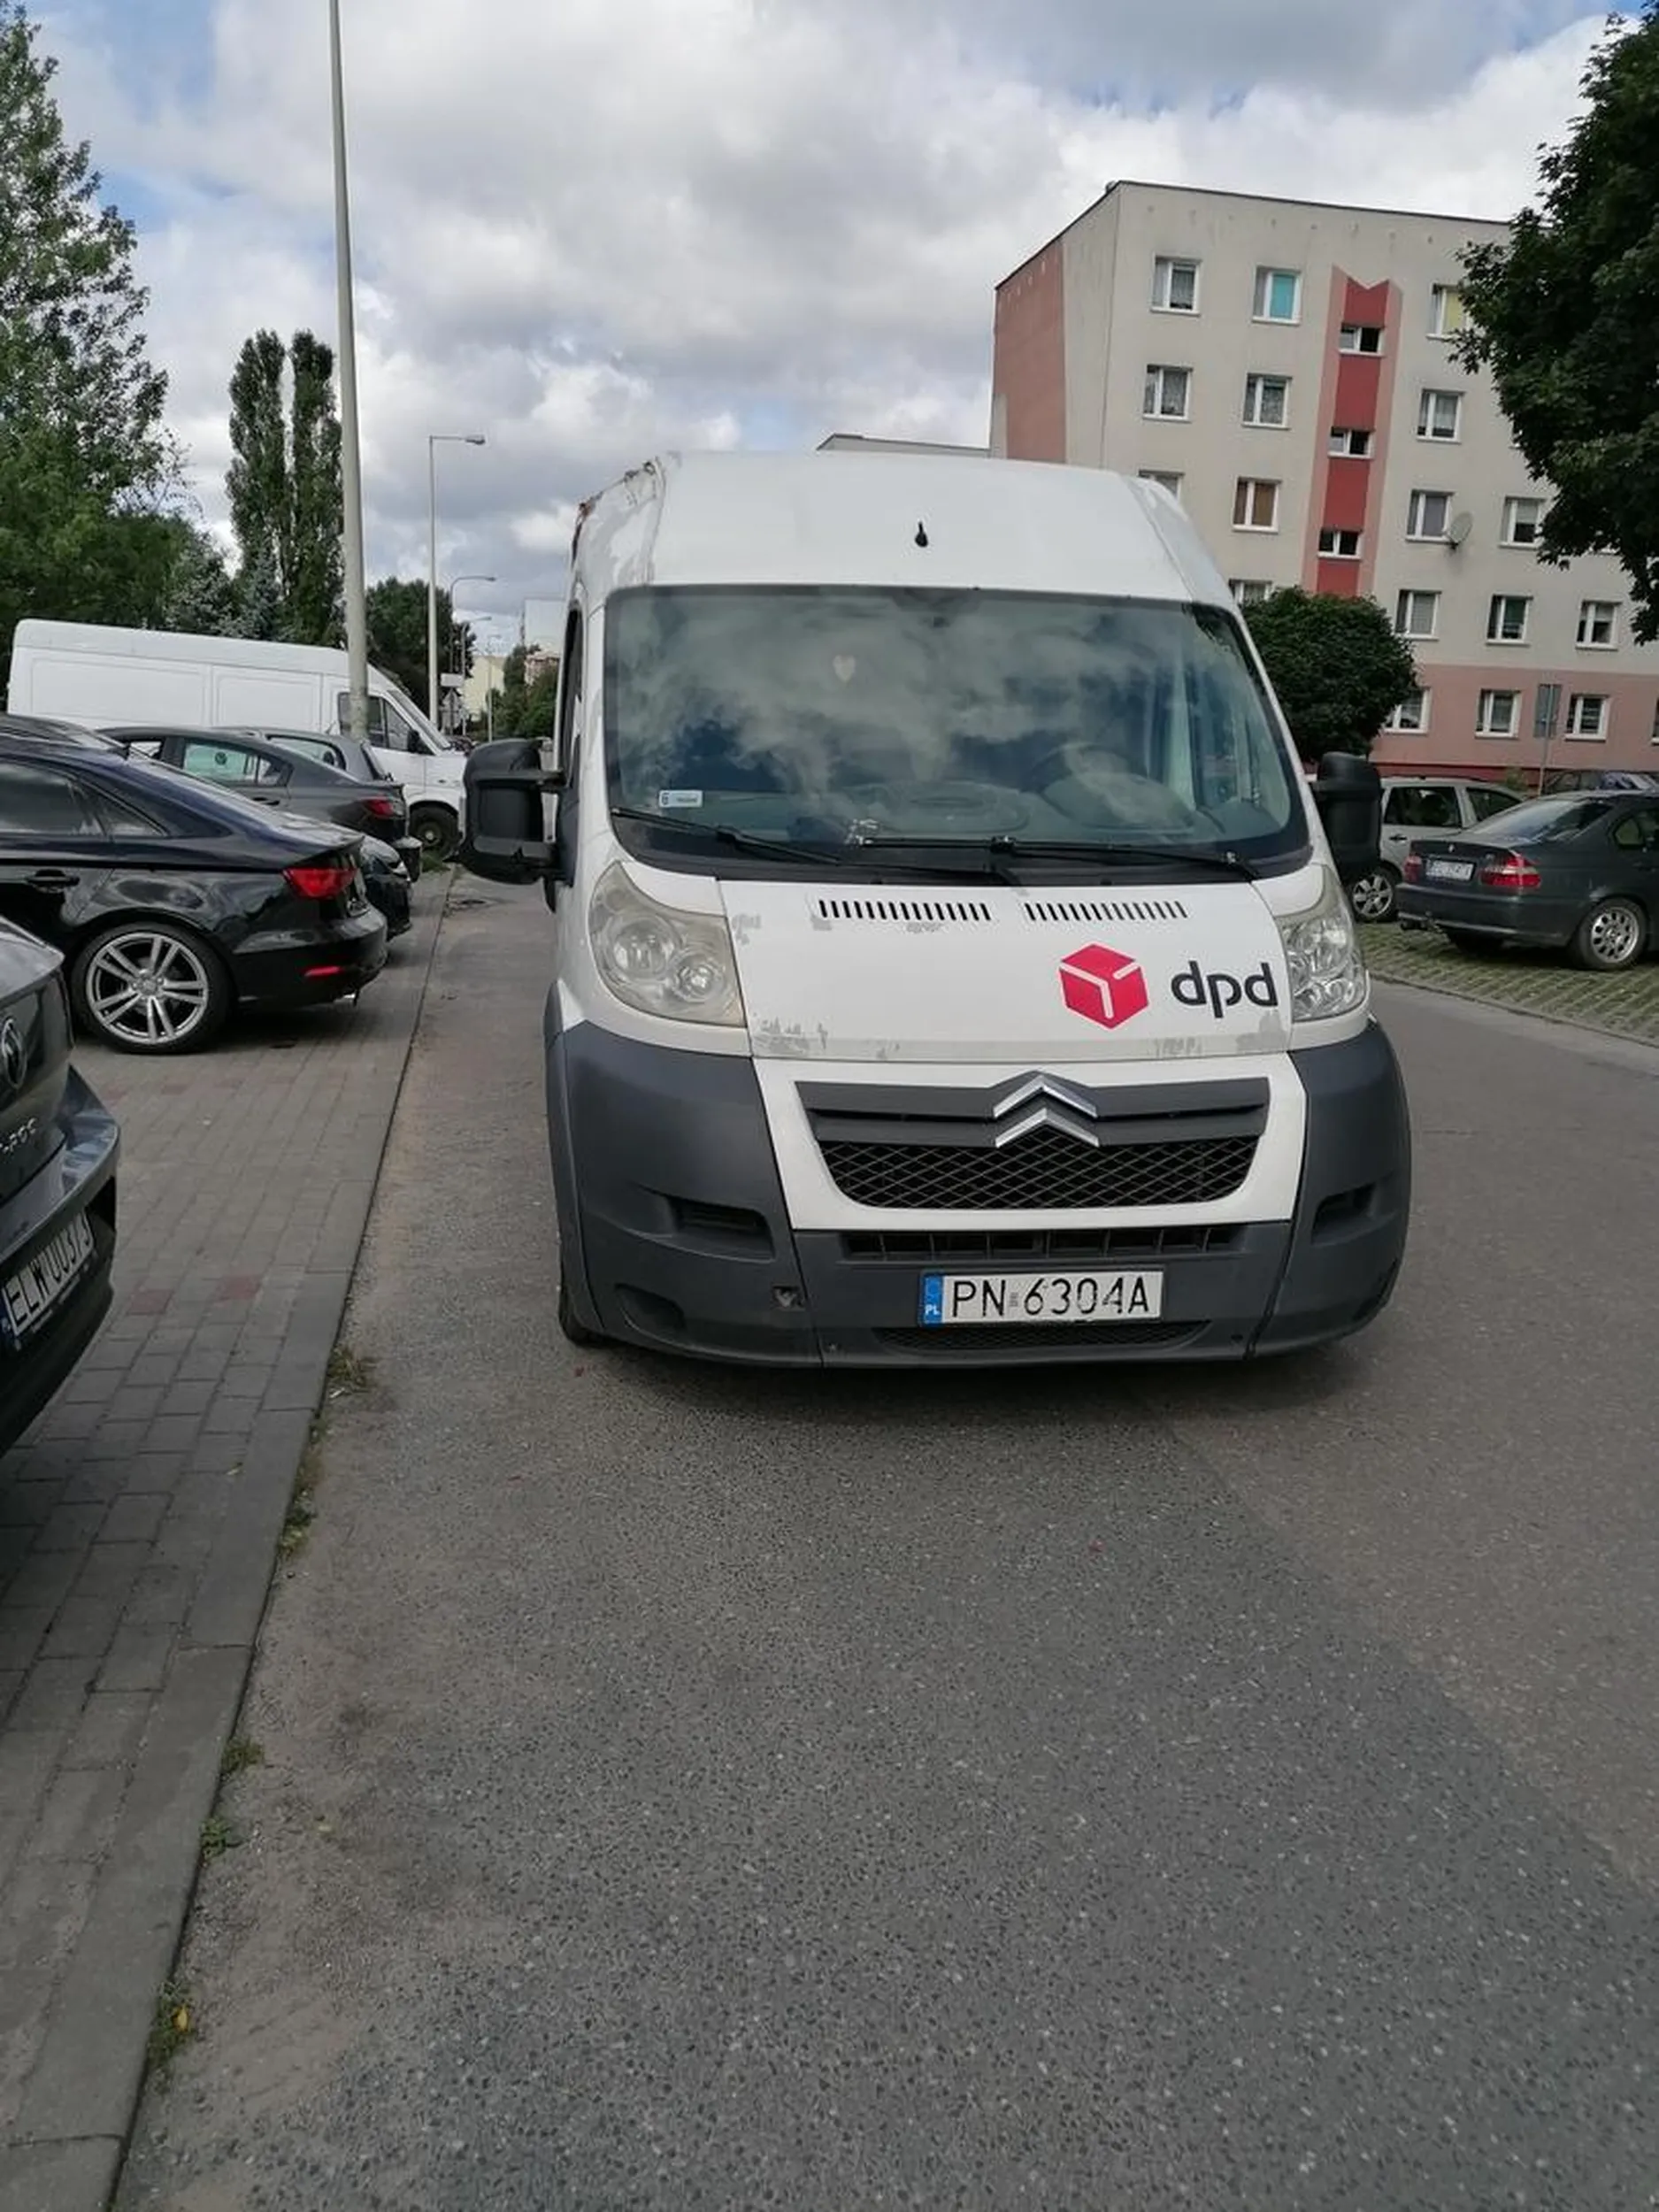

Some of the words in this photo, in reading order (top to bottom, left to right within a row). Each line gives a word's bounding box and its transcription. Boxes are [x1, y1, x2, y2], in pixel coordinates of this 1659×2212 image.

[1171, 960, 1278, 1018] dpd
[926, 1304, 940, 1315] PL
[952, 1279, 1006, 1317] PN
[1024, 1277, 1149, 1316] 6304A
